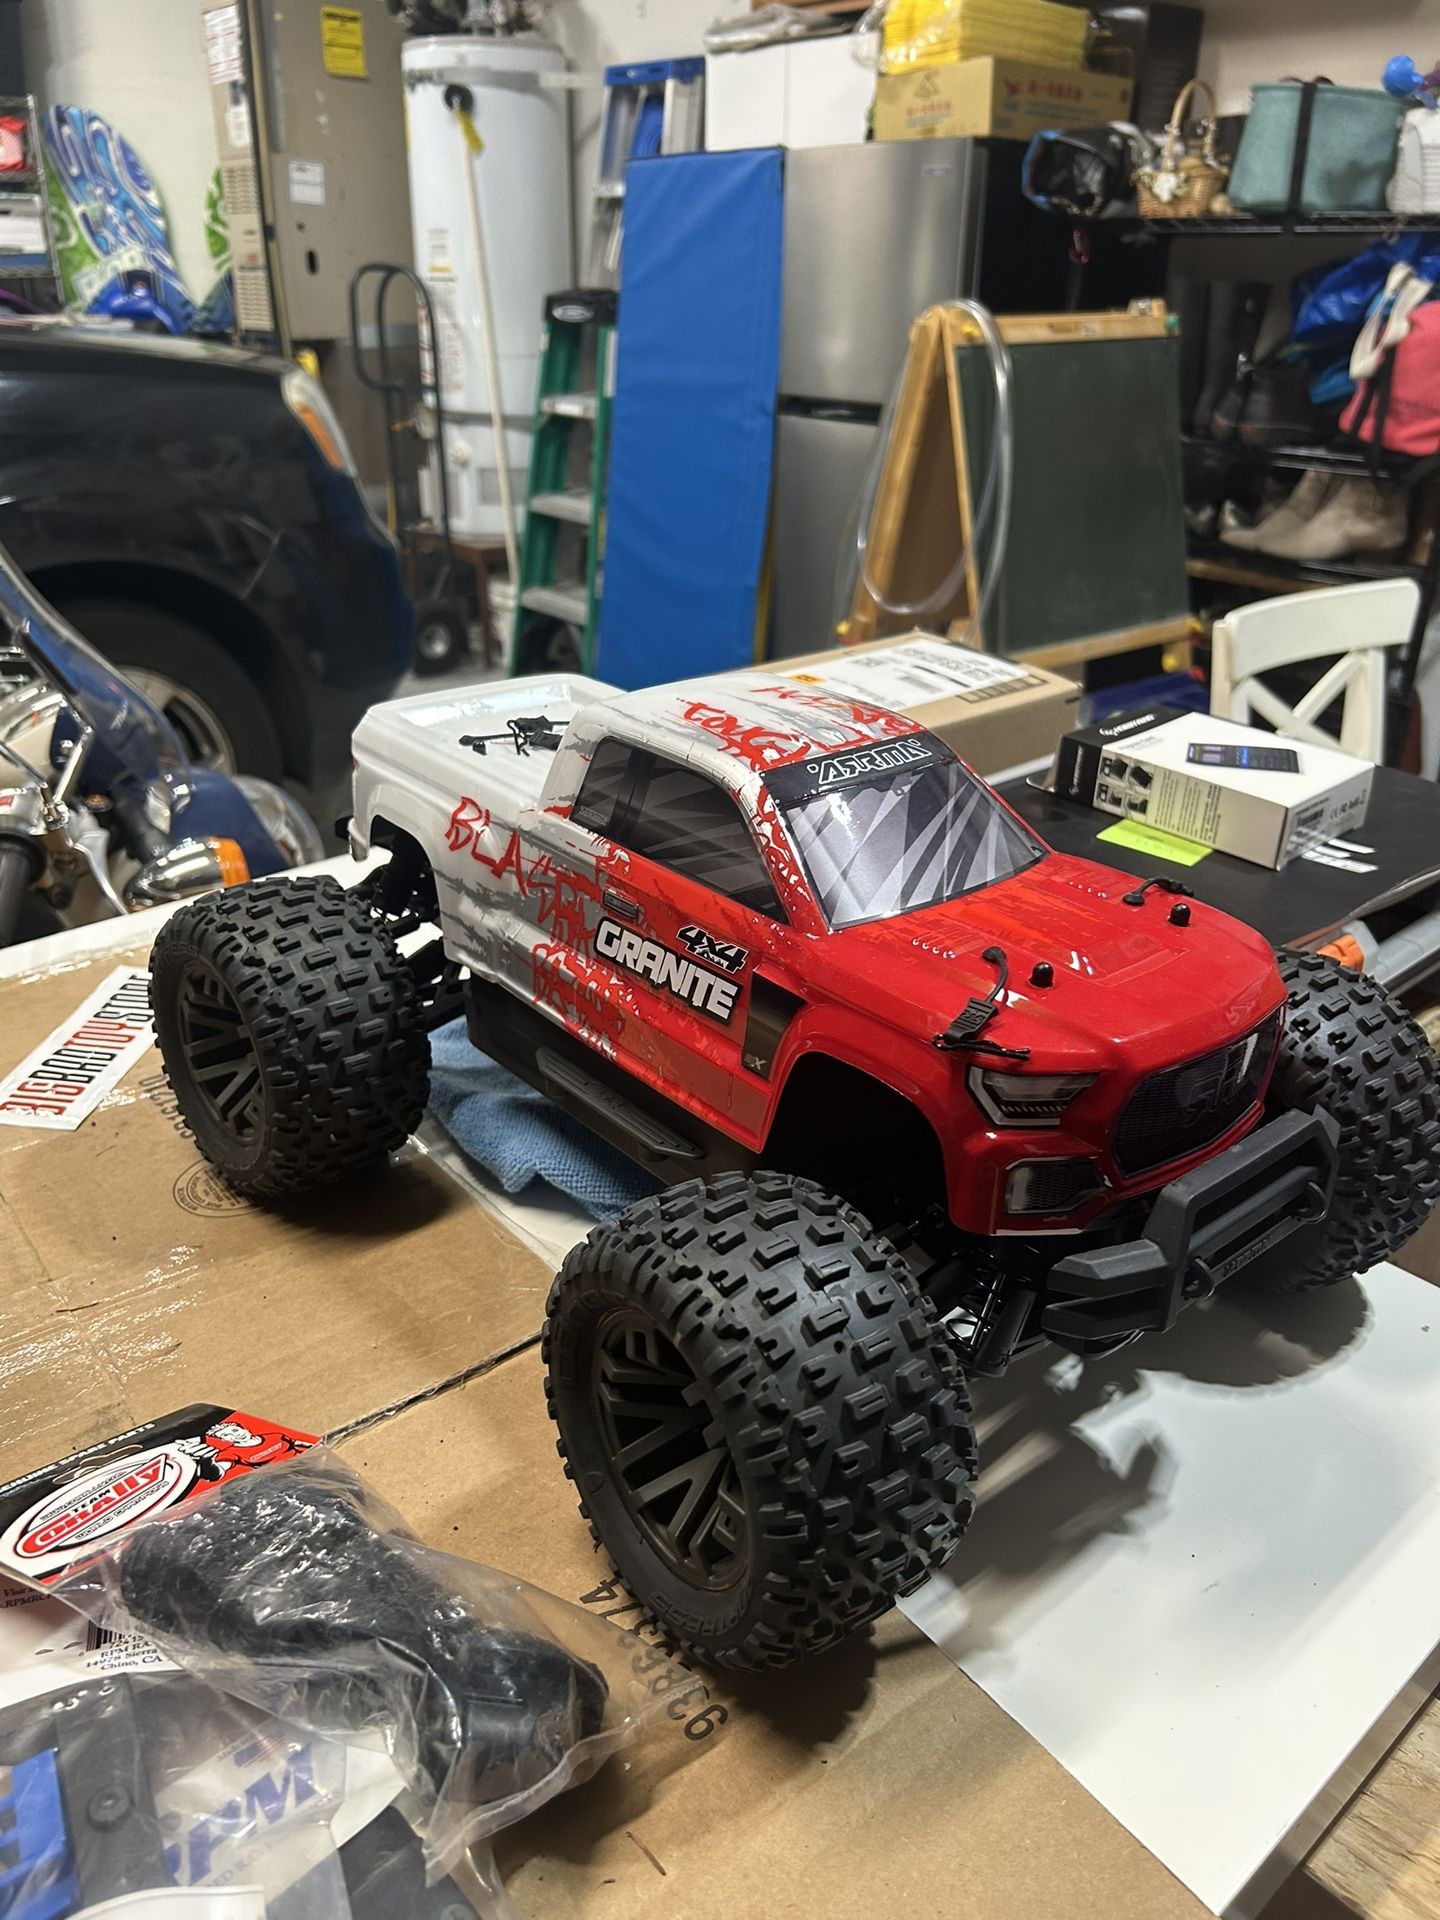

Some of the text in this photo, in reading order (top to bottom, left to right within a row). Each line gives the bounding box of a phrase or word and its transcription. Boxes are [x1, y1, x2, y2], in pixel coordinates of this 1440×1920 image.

[595, 918, 739, 1024] GRANITE
[0, 1463, 58, 1493] ENUINE
[72, 1488, 111, 1514] TEAM
[100, 1643, 129, 1658] RPM
[125, 1648, 158, 1660] Sierra
[100, 1655, 163, 1671] Chino, CA
